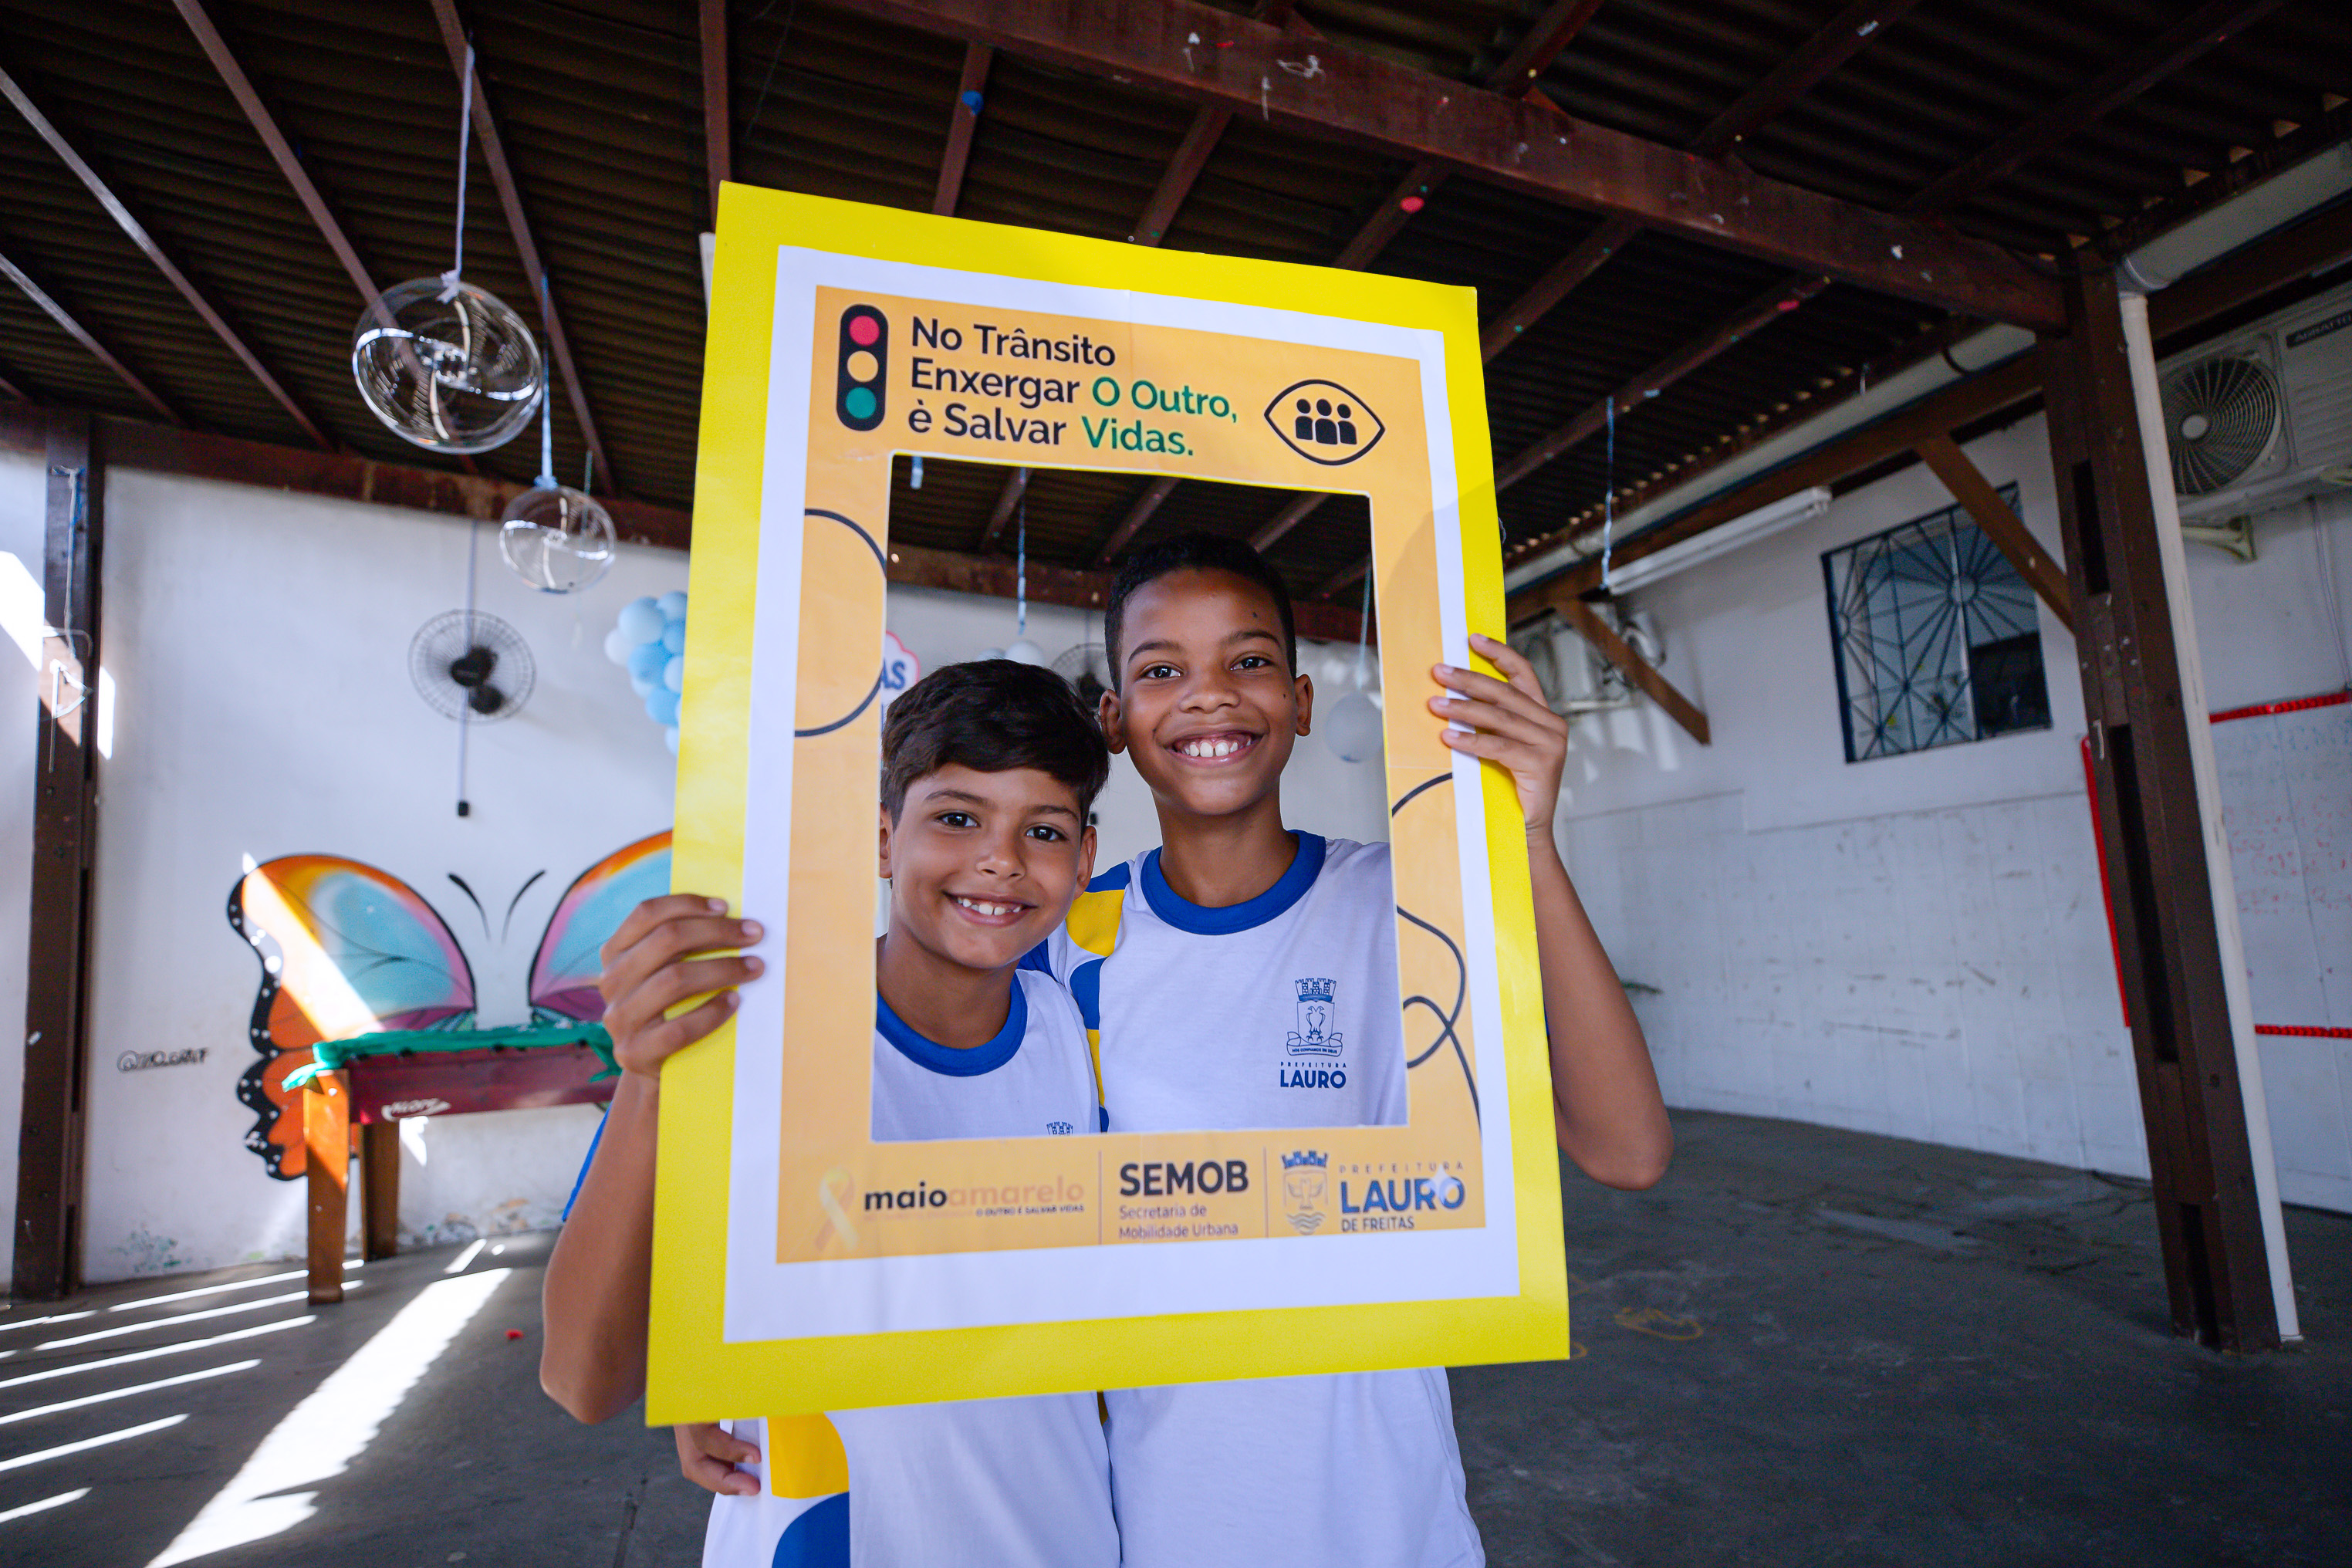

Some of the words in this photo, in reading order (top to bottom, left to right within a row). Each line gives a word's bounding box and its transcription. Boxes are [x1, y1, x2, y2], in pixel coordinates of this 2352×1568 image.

[911, 316, 962, 350] No
[973, 324, 1116, 366] Trânsito
[911, 356, 1080, 408] Enxergar
[1092, 376, 1120, 406] O
[1130, 378, 1238, 423] Outro,
[943, 404, 1066, 445] Salvar
[1081, 416, 1195, 456] Vidas.
[1280, 1070, 1347, 1089] LAURO
[1119, 1160, 1249, 1196] SEMOB
[1340, 1161, 1463, 1174] PREFEITURA
[1340, 1177, 1465, 1214] LAURO
[1119, 1204, 1186, 1220] Secretaria
[1190, 1202, 1207, 1217] de
[1342, 1218, 1358, 1232] DE
[1363, 1215, 1414, 1231] FREITAS
[1119, 1224, 1188, 1239] Mobilidade
[1192, 1222, 1239, 1237] Urbana
